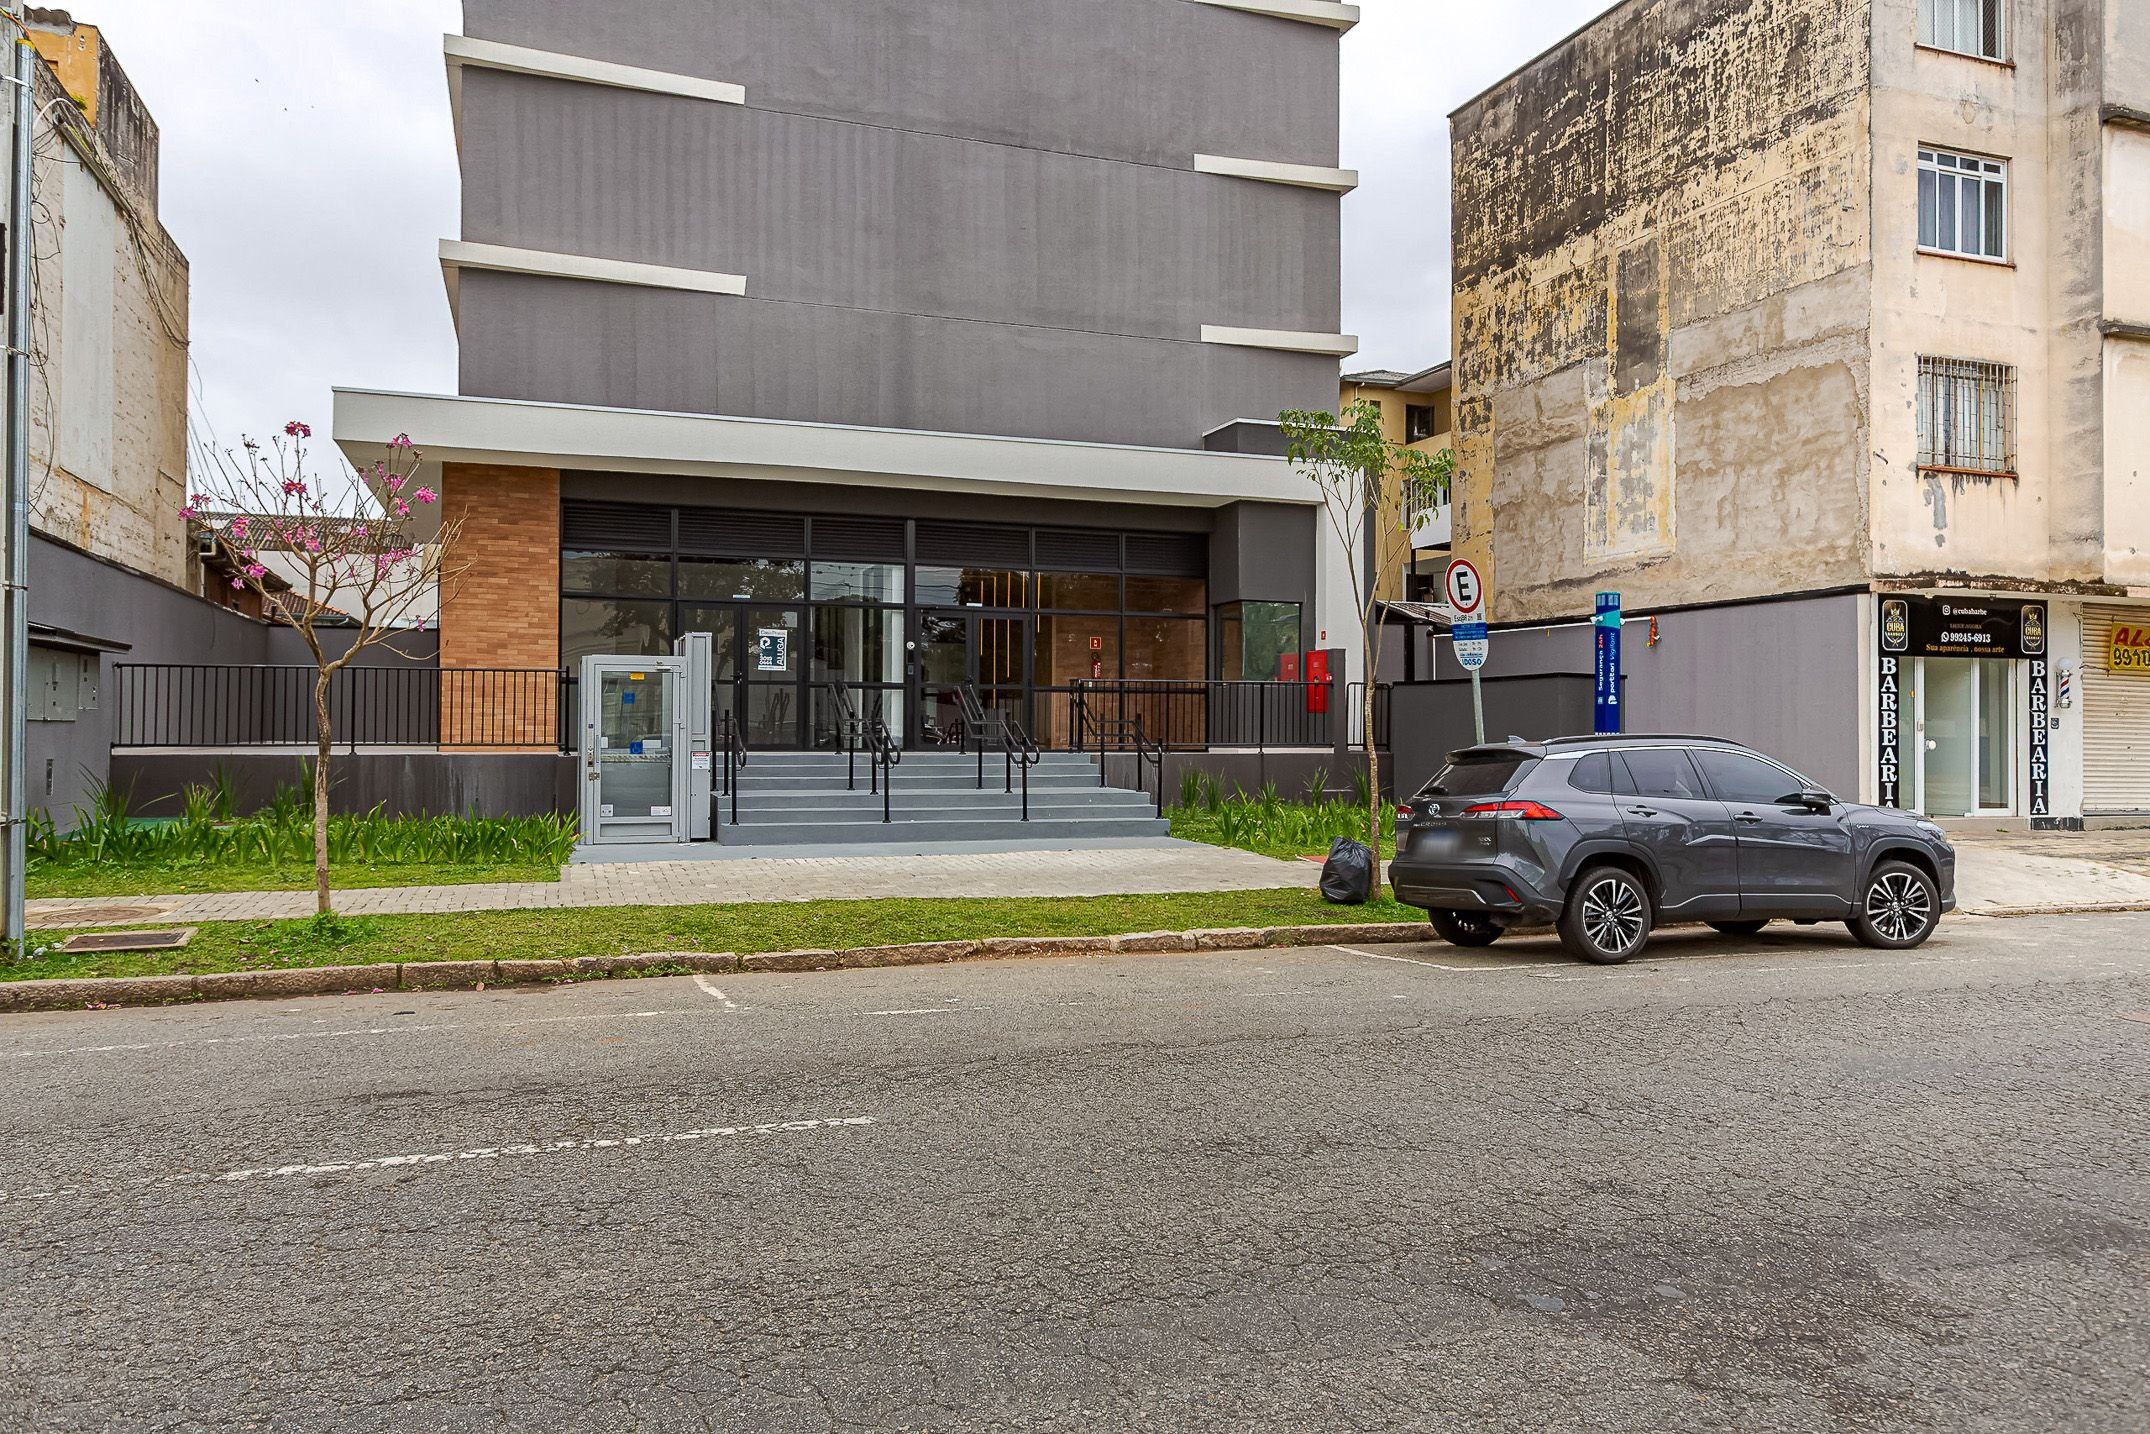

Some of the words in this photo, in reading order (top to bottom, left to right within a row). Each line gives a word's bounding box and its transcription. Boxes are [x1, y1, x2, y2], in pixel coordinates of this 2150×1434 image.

[1456, 571, 1472, 601] E
[1886, 622, 1904, 632] CUBA
[2025, 626, 2041, 636] CUBA
[1950, 632, 1991, 643] 99245-6913
[776, 637, 785, 665] ALUGA
[2031, 660, 2047, 814] BARBEARIA
